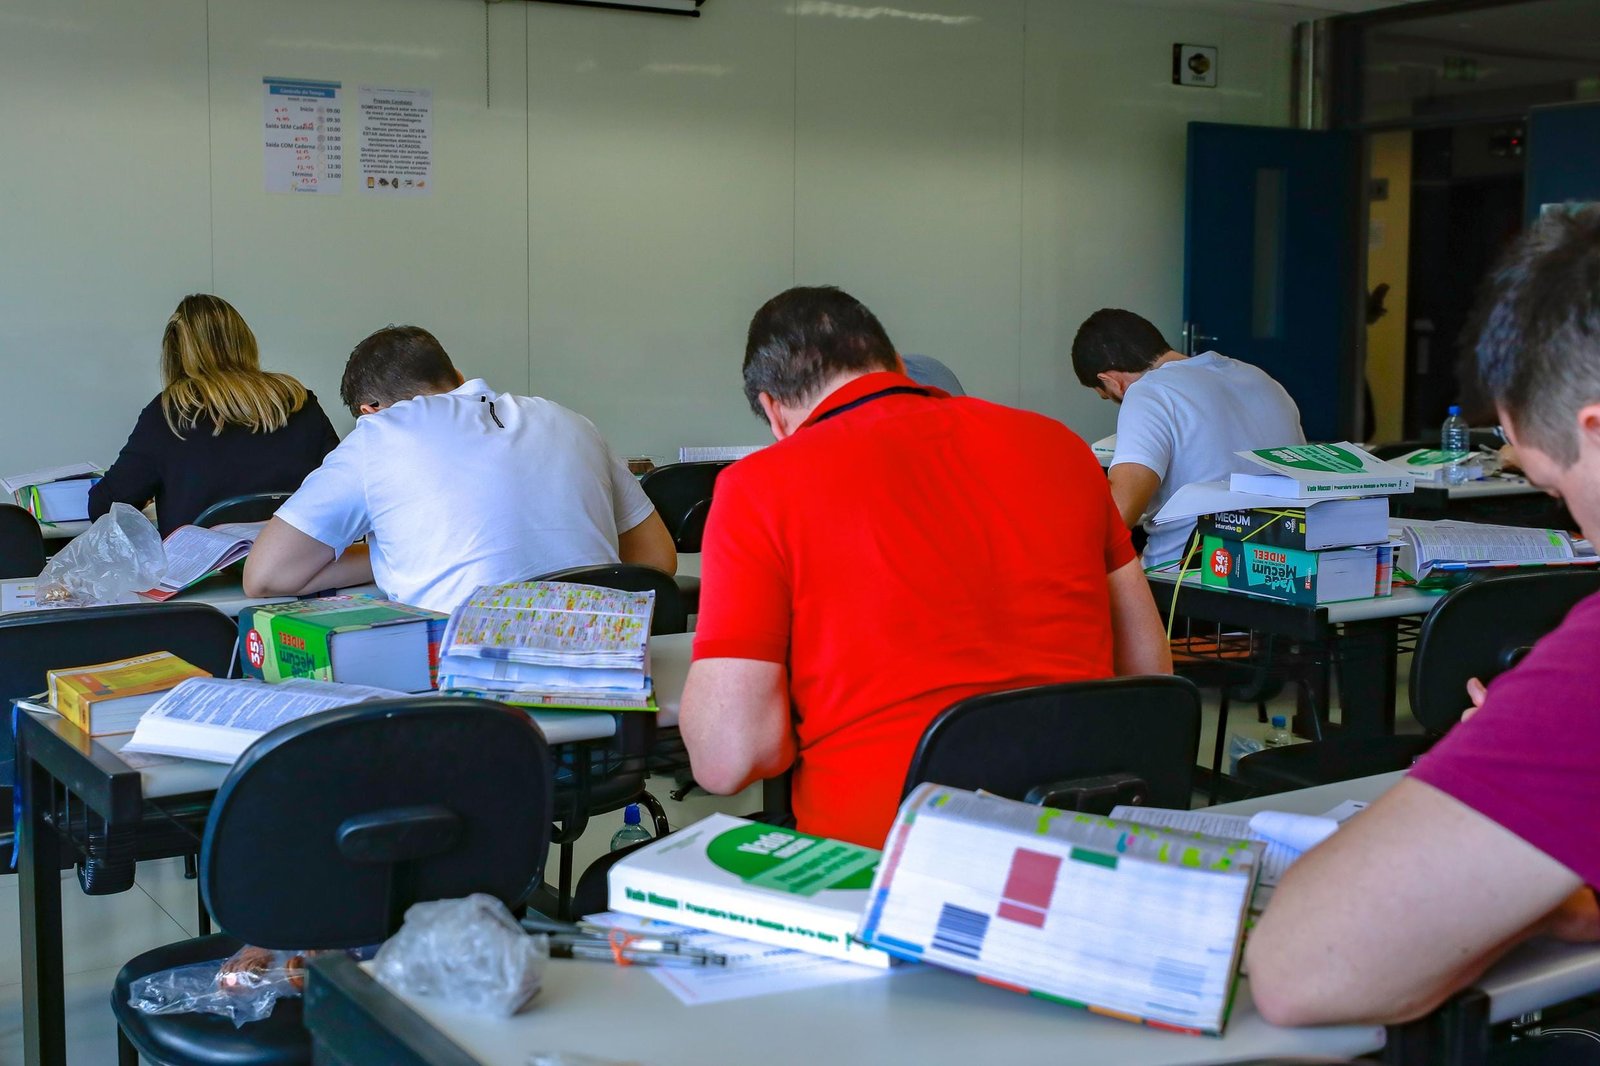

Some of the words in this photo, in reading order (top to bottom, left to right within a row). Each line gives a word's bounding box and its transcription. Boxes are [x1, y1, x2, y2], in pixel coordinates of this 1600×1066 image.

[1215, 513, 1251, 528] MECUM
[1215, 524, 1236, 532] interativo
[1254, 550, 1286, 564] RIDEEL
[1252, 564, 1297, 580] Mecum
[1265, 575, 1297, 594] Vade
[279, 631, 306, 650] RIDEEL
[280, 650, 315, 672] Mecum
